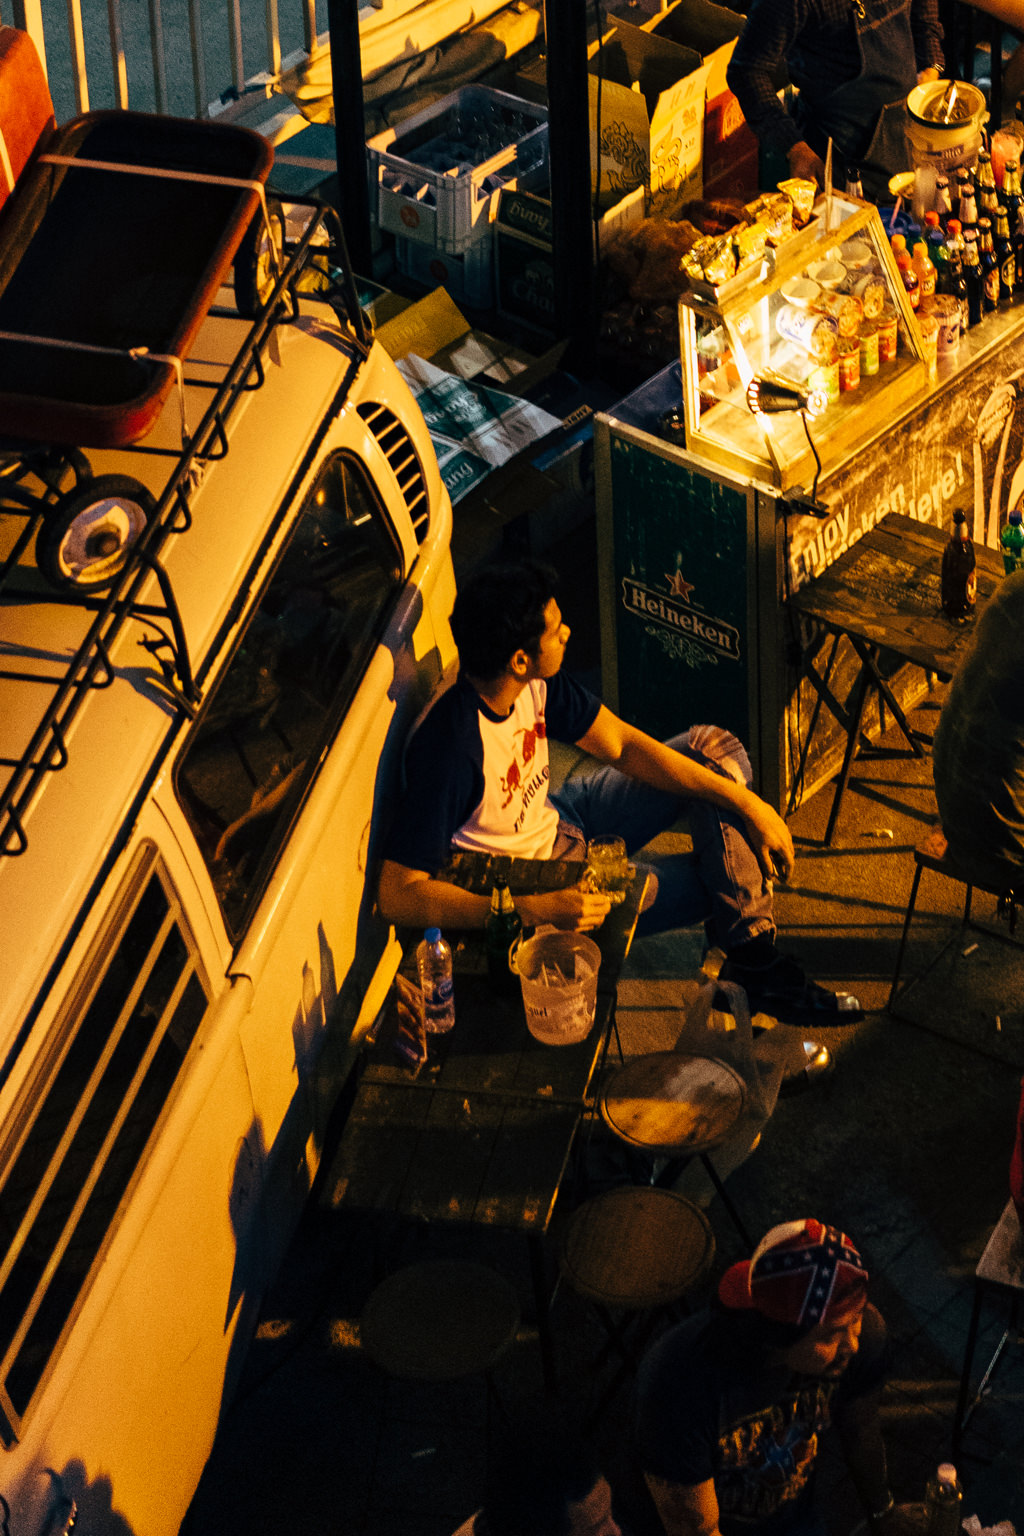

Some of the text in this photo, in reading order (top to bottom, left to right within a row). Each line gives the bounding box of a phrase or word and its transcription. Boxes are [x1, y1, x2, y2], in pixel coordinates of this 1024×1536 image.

[509, 201, 552, 236] hang
[513, 278, 554, 314] Cha
[446, 461, 475, 491] ang
[788, 503, 850, 592] Enjoy
[631, 587, 732, 650] Heineken
